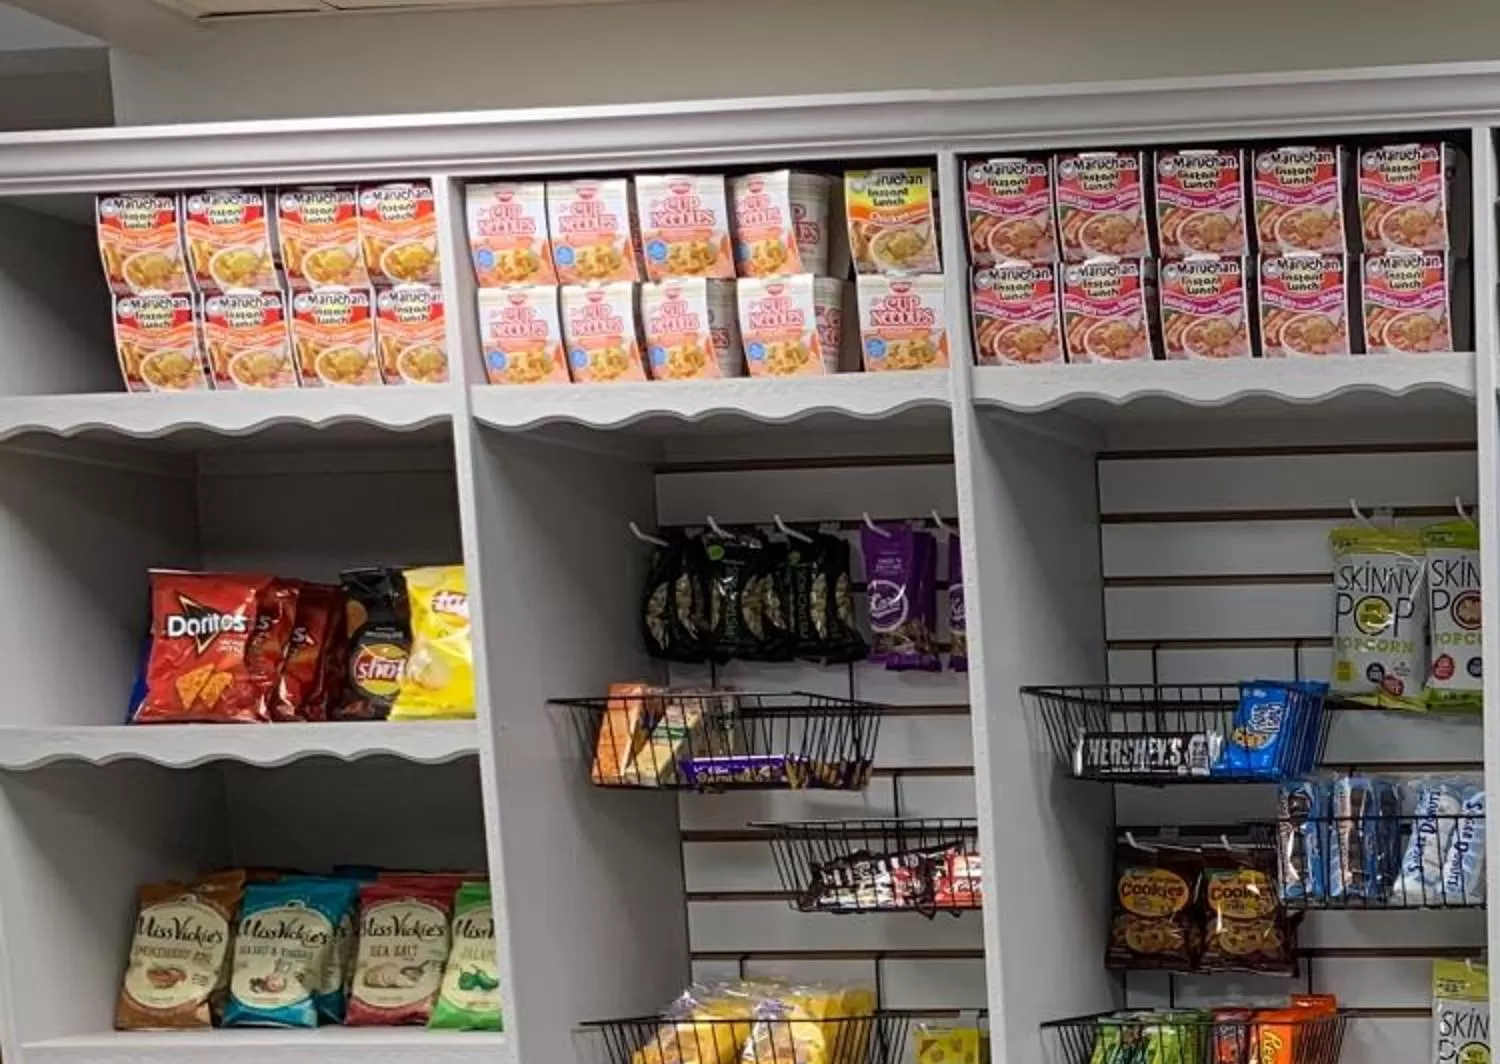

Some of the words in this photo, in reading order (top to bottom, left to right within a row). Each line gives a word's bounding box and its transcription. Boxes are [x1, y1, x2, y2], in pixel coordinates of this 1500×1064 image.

[1338, 561, 1419, 594] SKINNY
[1431, 555, 1481, 587] SKIN
[167, 612, 248, 638] Doritos
[1335, 593, 1414, 637] POP
[1431, 589, 1482, 631] PO
[1442, 1007, 1490, 1040] SKIN
